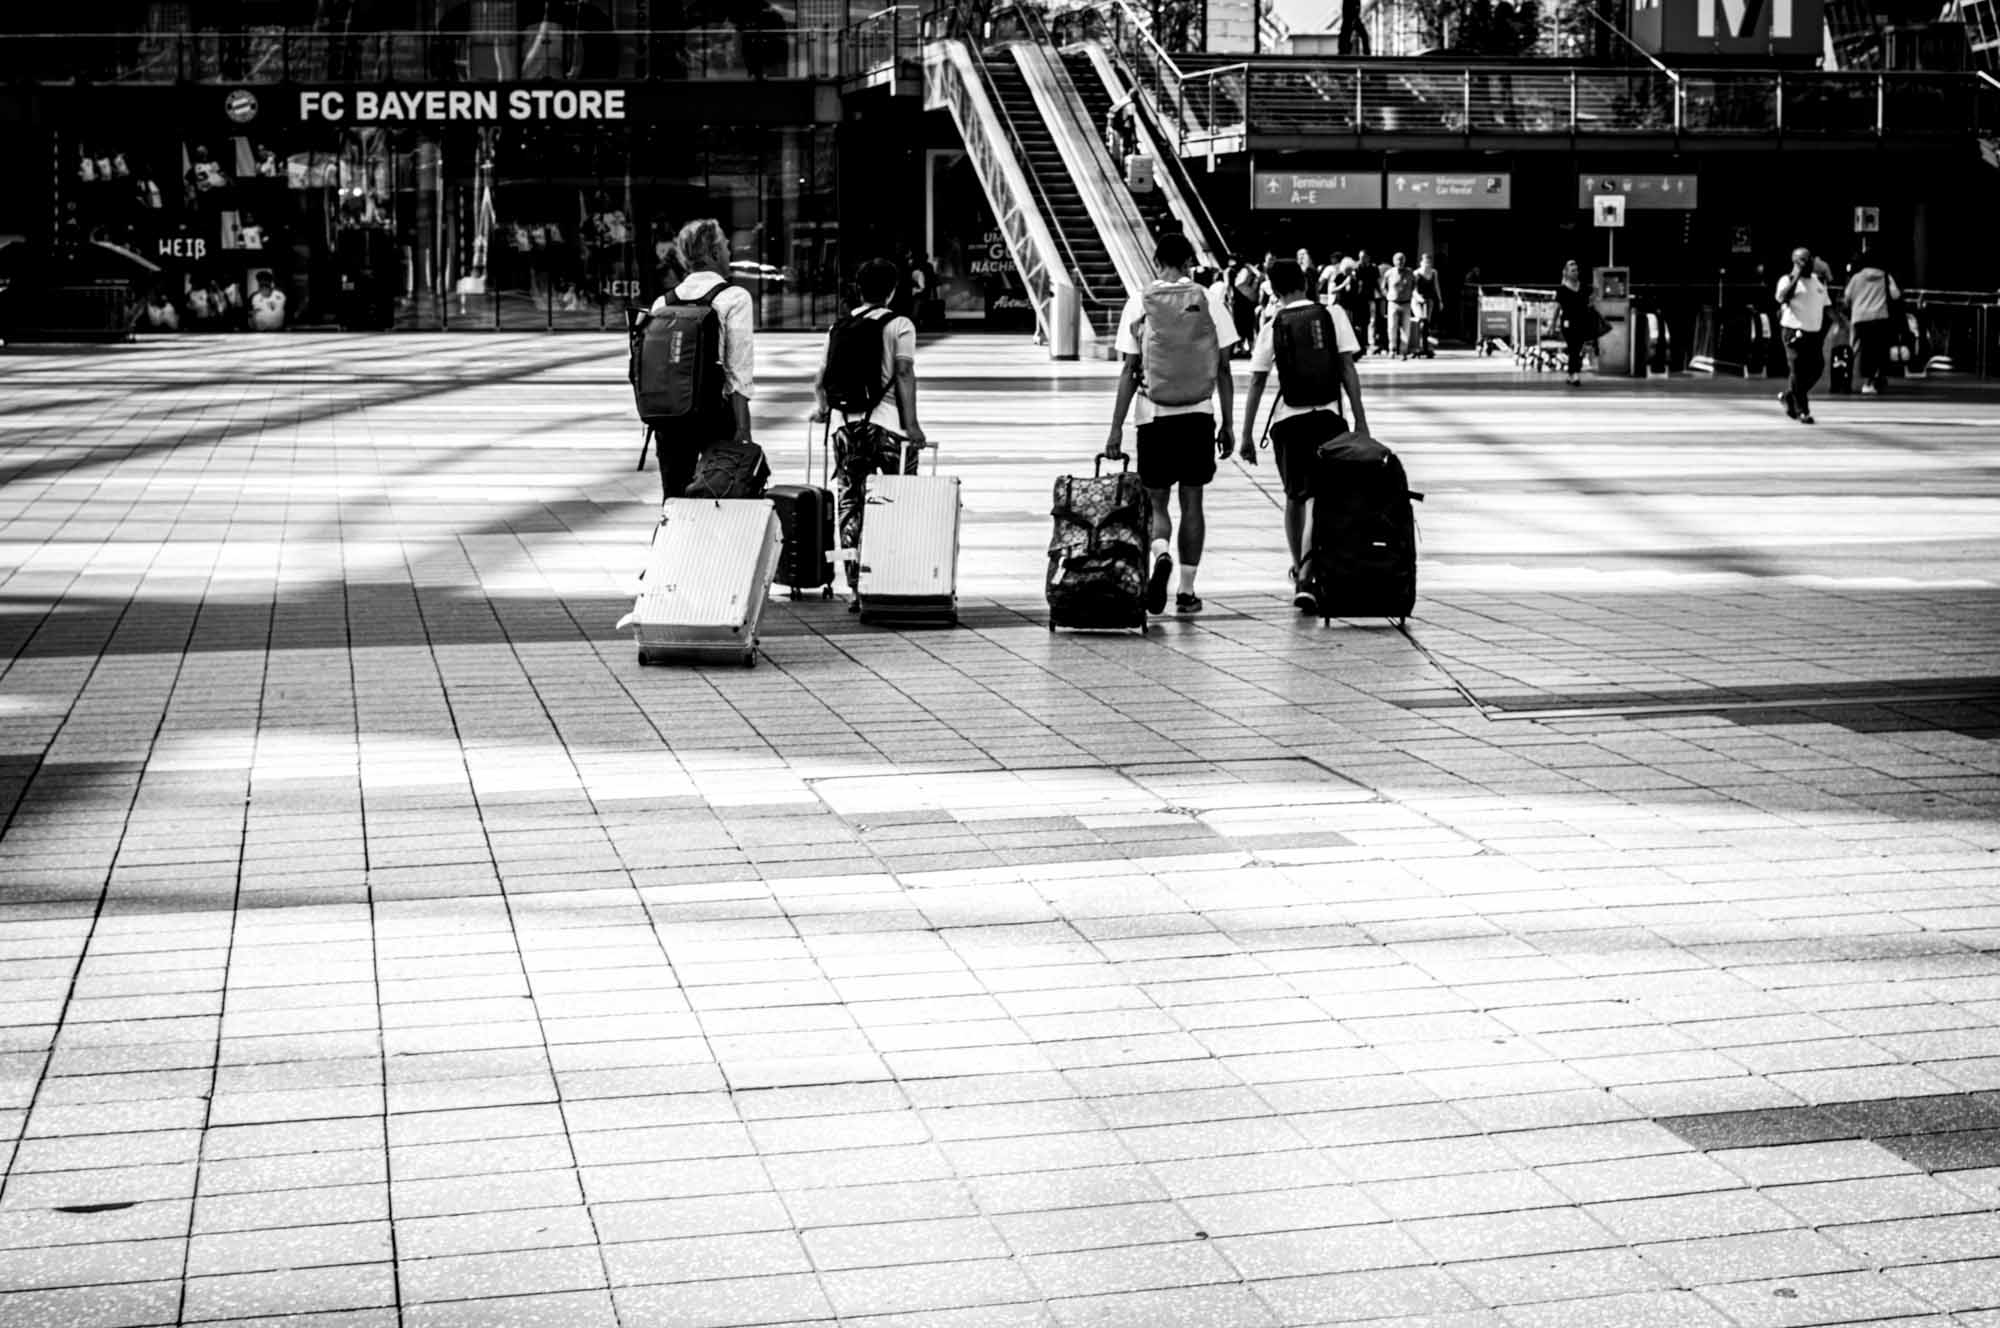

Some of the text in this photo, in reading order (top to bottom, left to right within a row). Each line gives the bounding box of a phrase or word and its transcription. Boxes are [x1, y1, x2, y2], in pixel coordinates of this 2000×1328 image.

[299, 89, 626, 121] FC BAYERN STORE
[1290, 175, 1347, 189] Terminal 1
